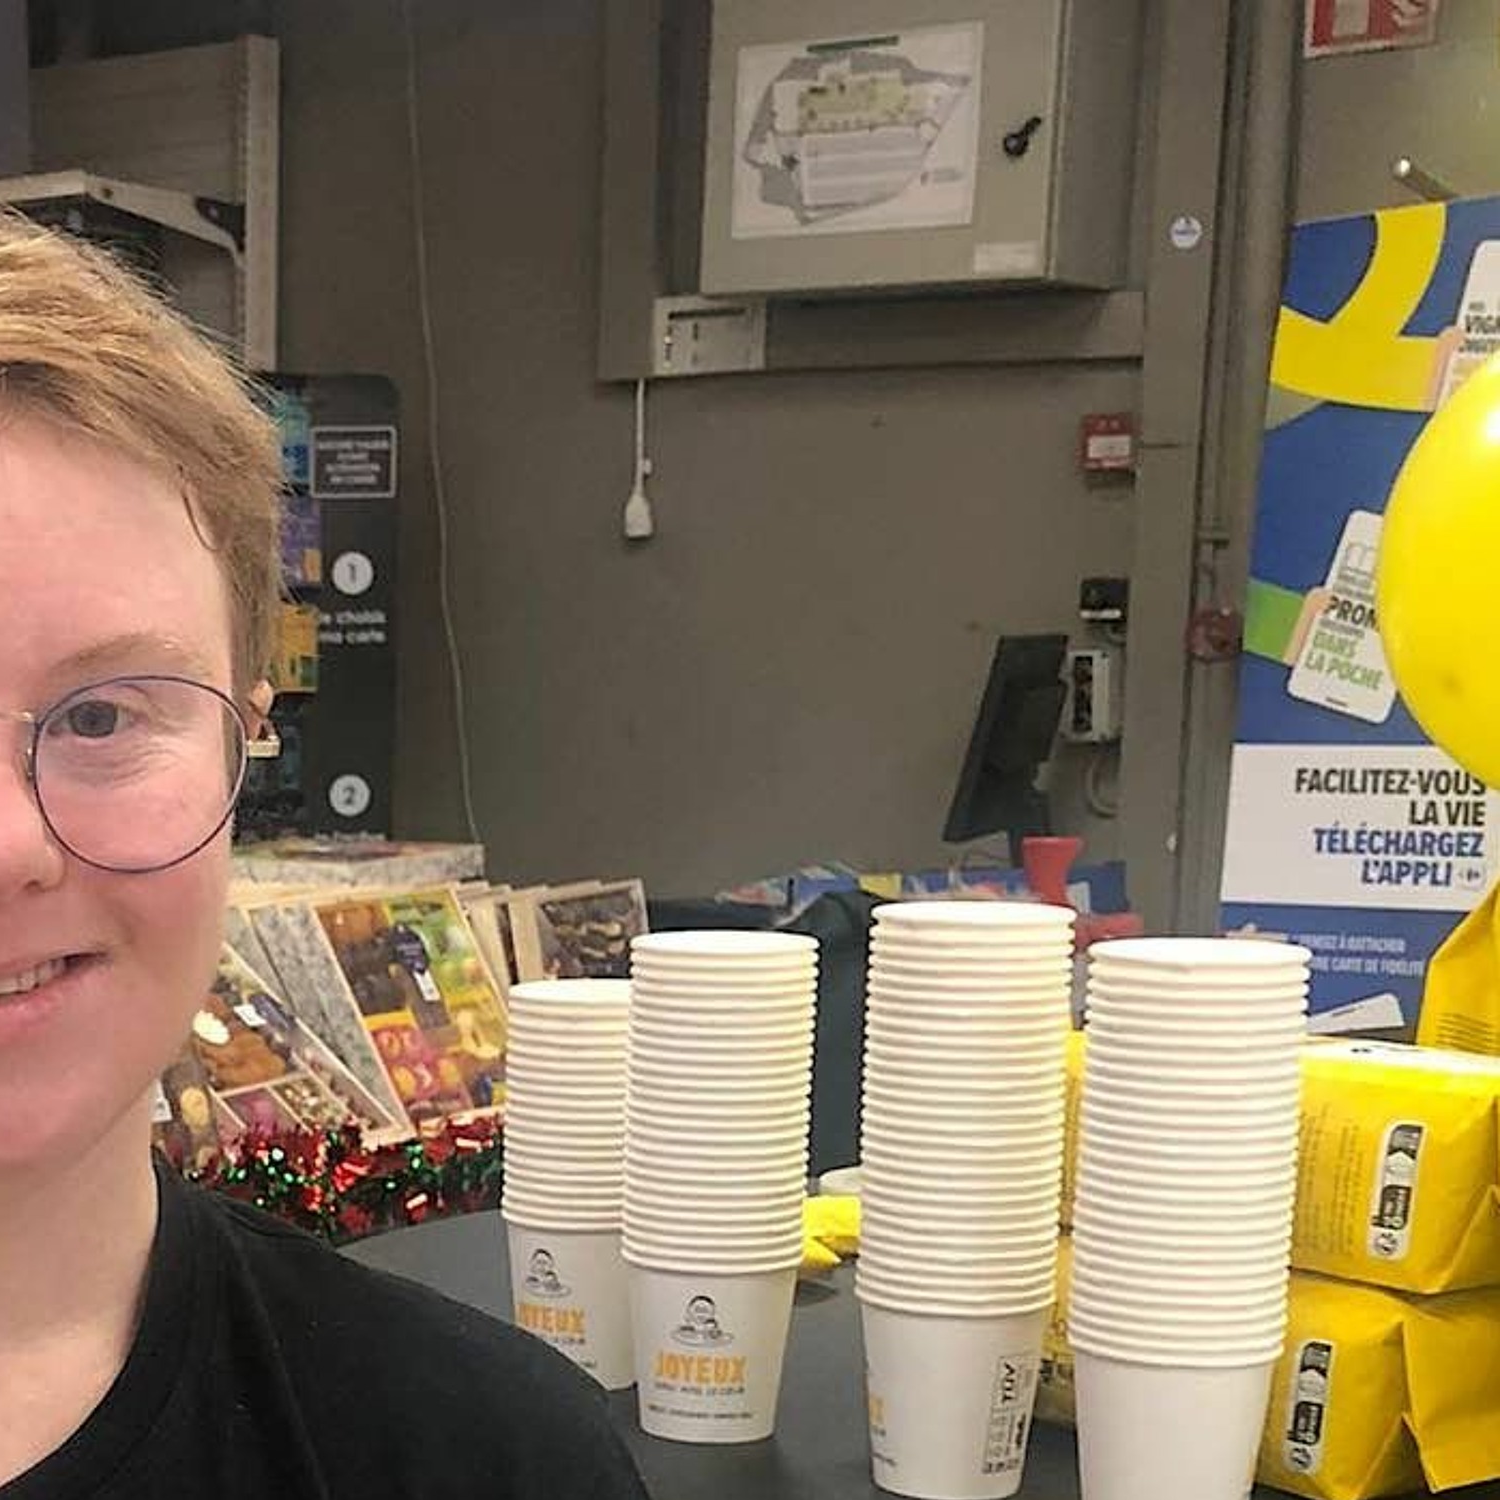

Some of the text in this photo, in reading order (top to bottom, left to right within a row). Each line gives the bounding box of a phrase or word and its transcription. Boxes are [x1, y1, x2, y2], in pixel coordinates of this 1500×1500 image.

[1305, 652, 1383, 690] LA POCHE
[1295, 767, 1486, 796] FACILITEZ-VOUS
[1409, 801, 1486, 826] LA VIE
[1313, 821, 1484, 857] TÉLÉCHARGEZ
[1361, 860, 1452, 886] L'APPLI
[654, 1353, 746, 1384] JOYEUX
